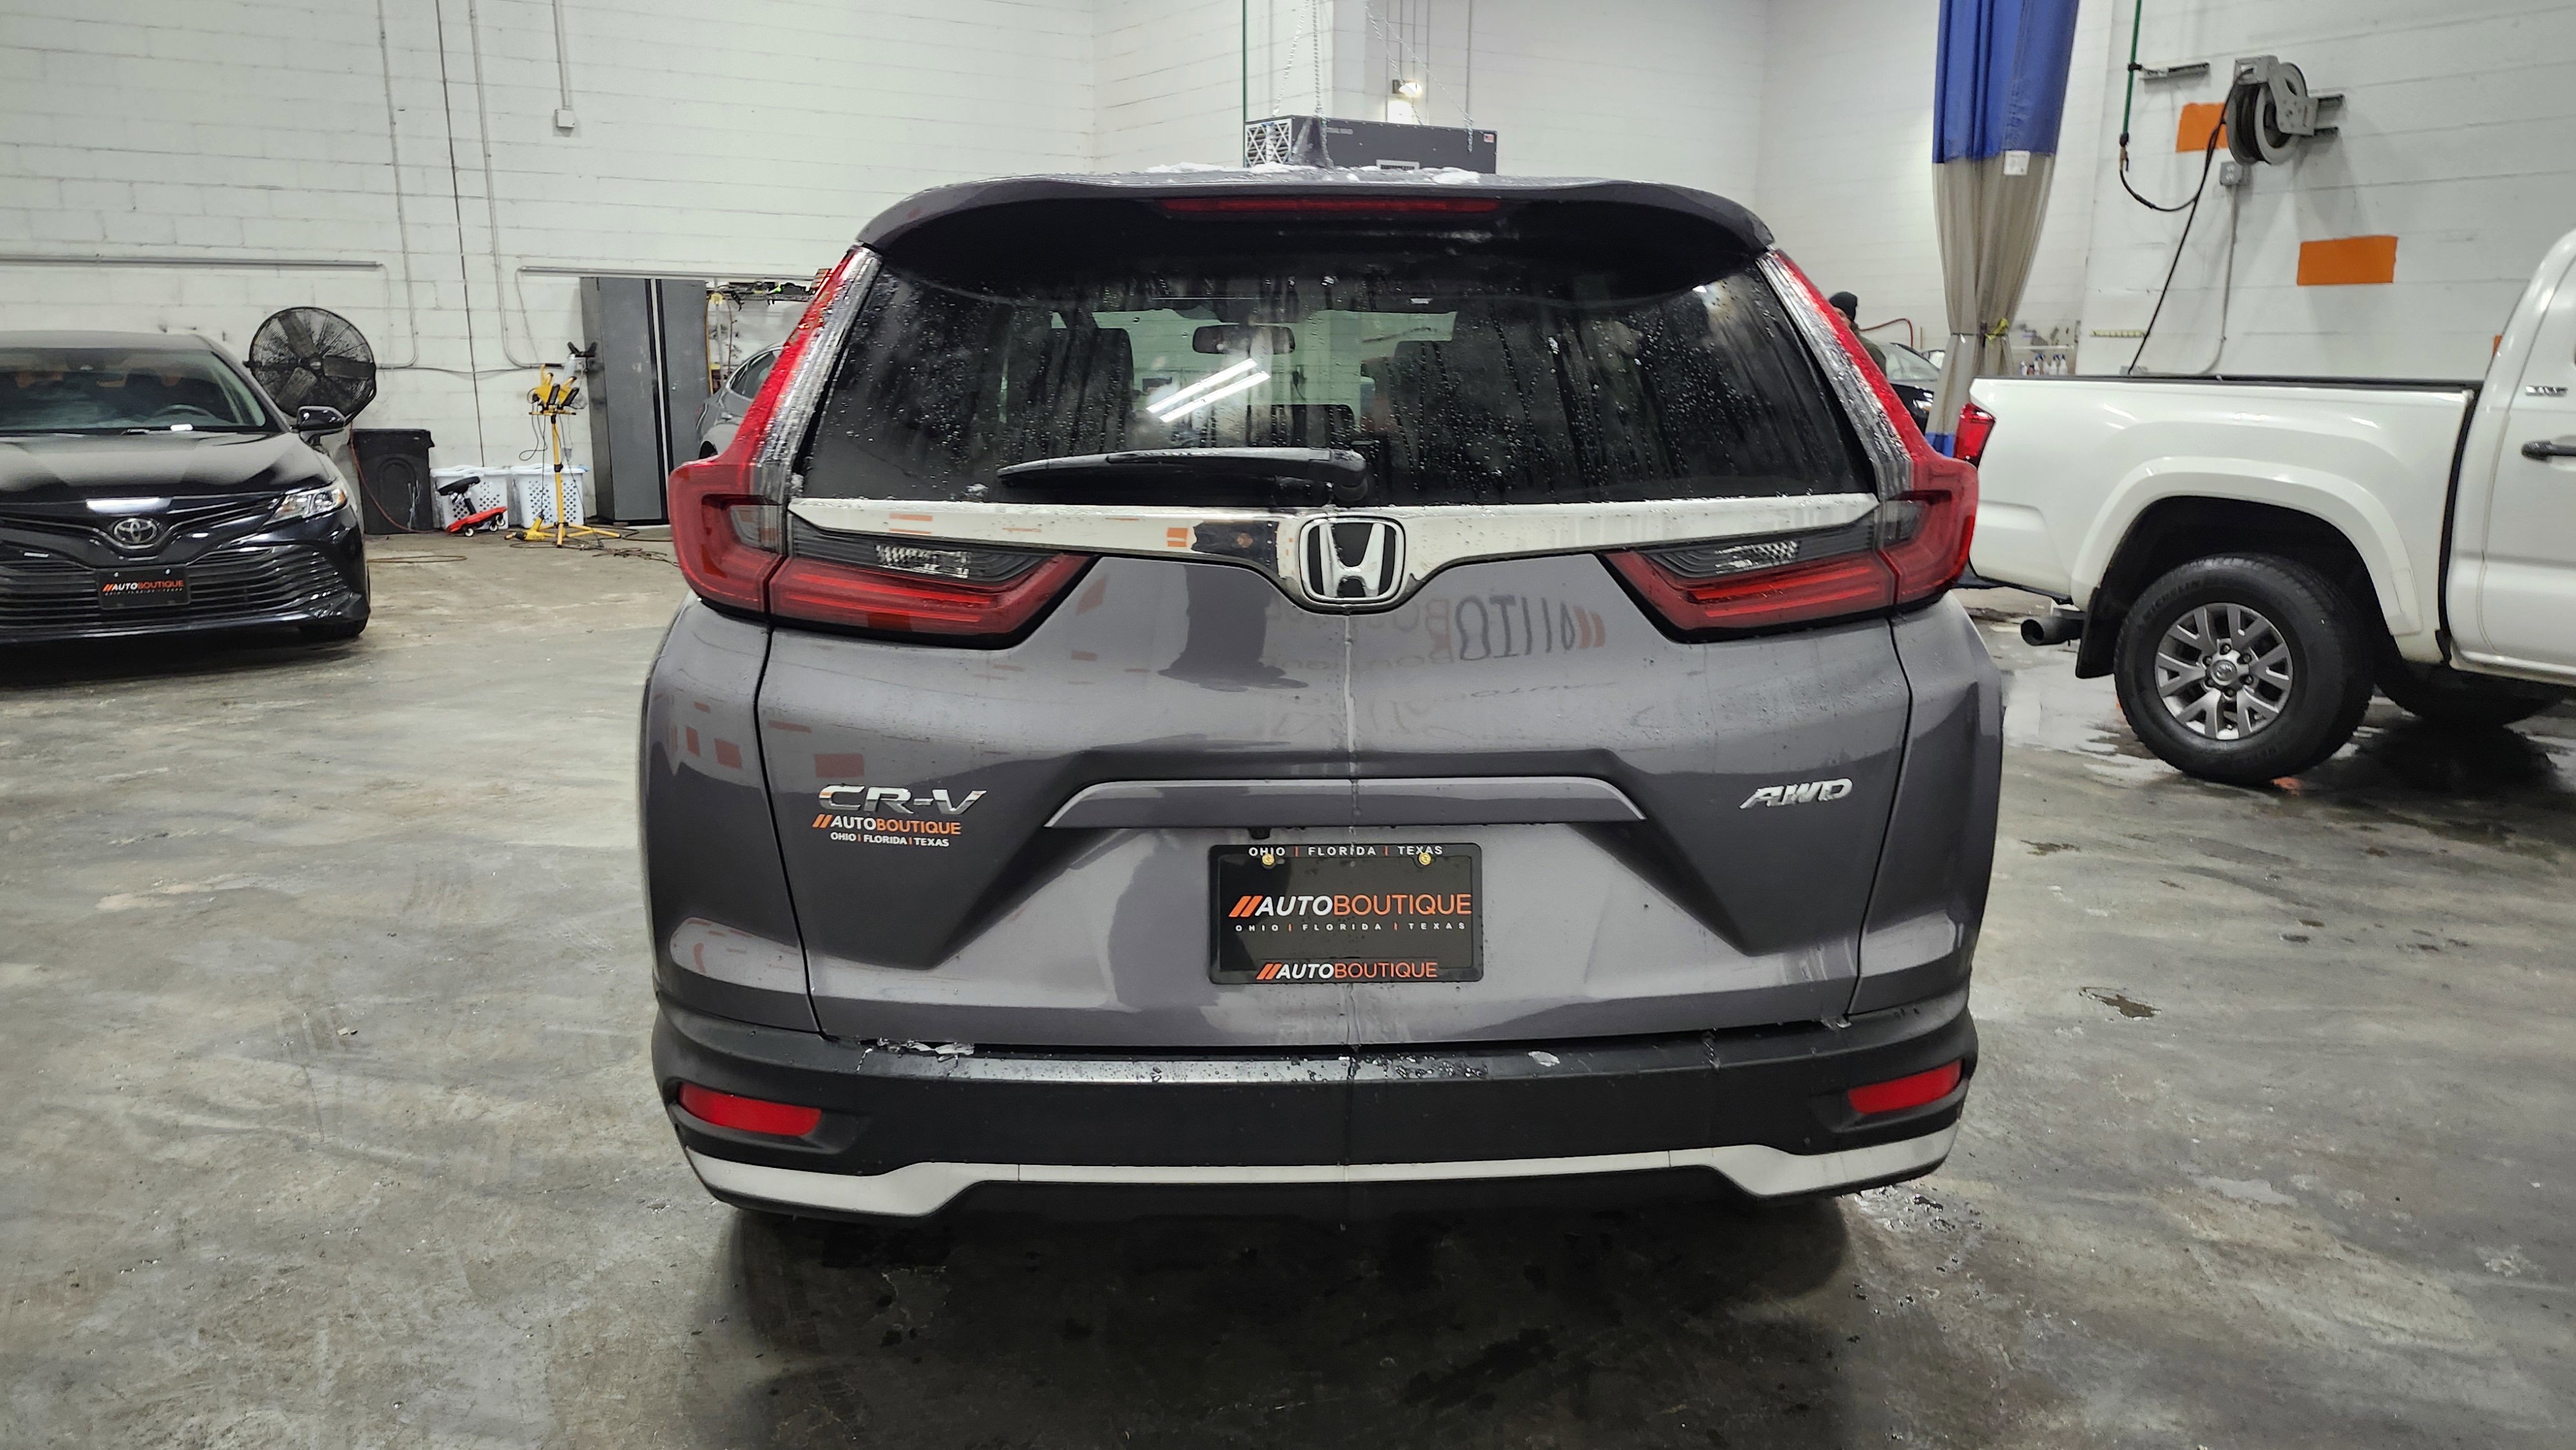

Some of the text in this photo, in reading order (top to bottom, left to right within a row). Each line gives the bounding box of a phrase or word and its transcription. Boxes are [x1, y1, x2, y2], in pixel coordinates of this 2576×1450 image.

[818, 784, 987, 815] CR-V
[1739, 777, 1853, 809] AWD
[830, 816, 961, 835] AUTOBOUTIQUE
[830, 833, 950, 847] OHIO FLORIDA TEXAS
[1248, 845, 1443, 856] OHIO FLORIDA TEXAS
[1255, 894, 1472, 916] AUTOBOUTIQUE
[1408, 922, 1466, 930] TEXAS
[1275, 963, 1438, 979] AUTOBOUTIQUE
